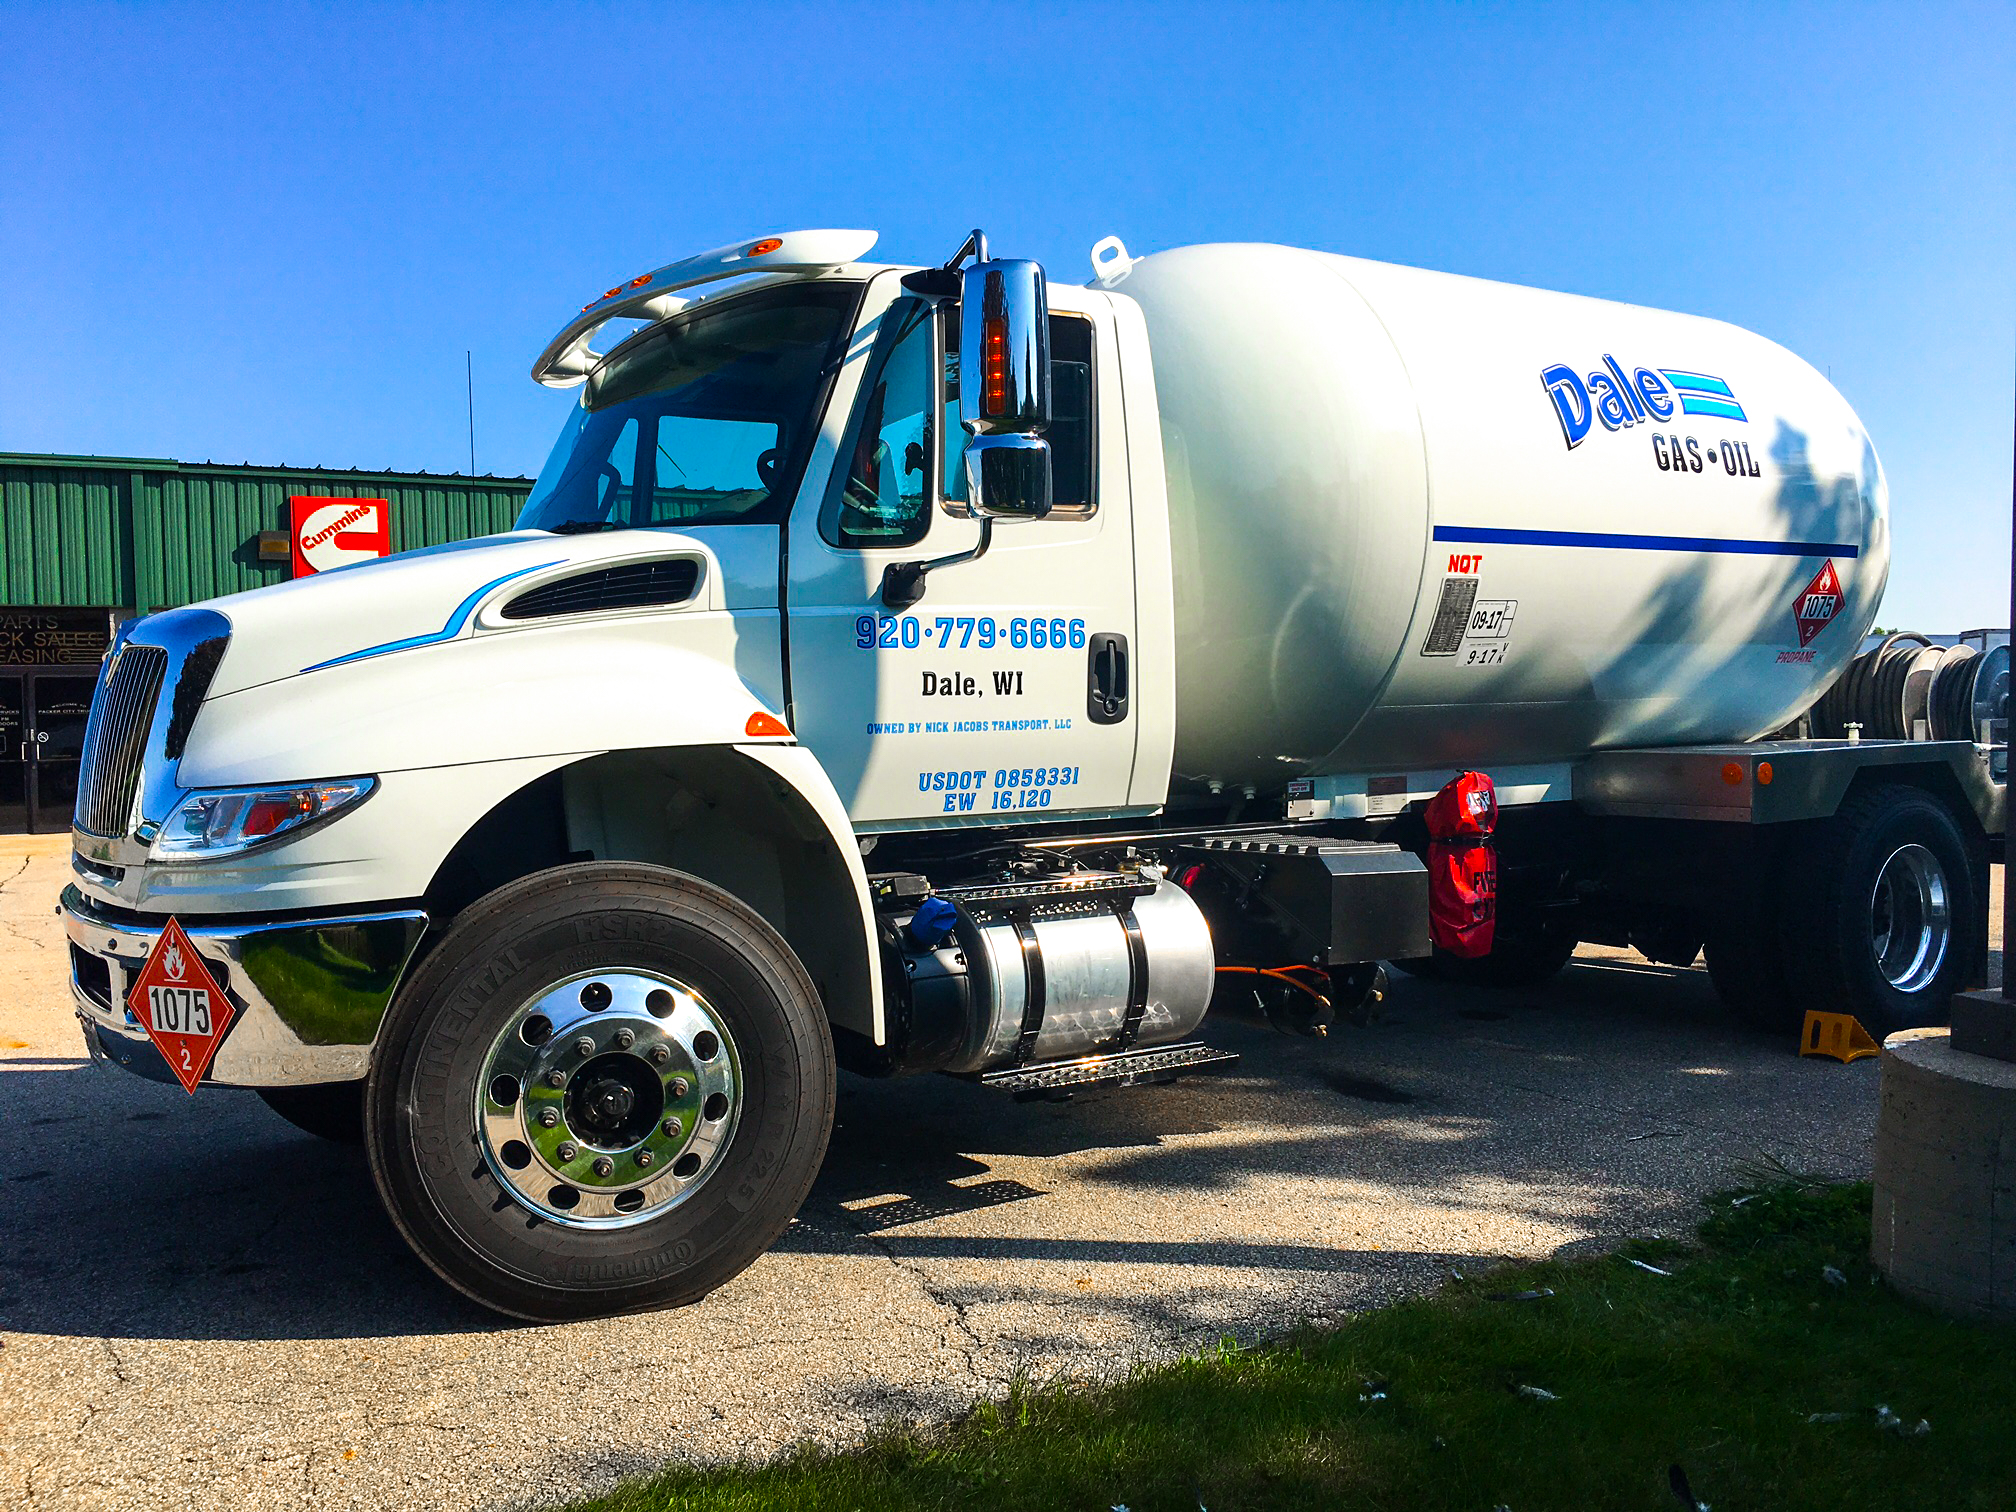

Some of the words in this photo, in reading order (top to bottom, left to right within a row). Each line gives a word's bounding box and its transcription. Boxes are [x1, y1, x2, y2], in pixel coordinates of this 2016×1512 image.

[1540, 354, 1674, 451] Dale
[302, 506, 371, 550] Cummins
[1804, 596, 1835, 618] 1075
[1472, 611, 1503, 630] 09-17
[1805, 626, 1814, 637] 2
[34, 632, 98, 647] SALES
[1776, 651, 1817, 664] PROPANE
[922, 671, 983, 698] Dale,
[992, 671, 1023, 696] WI
[867, 722, 905, 735] OWNED
[908, 722, 922, 734] BY
[925, 721, 949, 733] NICK
[953, 720, 989, 732] JACOBS
[1054, 718, 1072, 730] LLC
[919, 771, 987, 792] USDOT
[994, 767, 1079, 788] 0858331
[943, 793, 977, 812] EW
[992, 789, 1052, 810] 16,120
[575, 915, 675, 944] HSR2
[151, 987, 210, 1034] 1075
[180, 1049, 192, 1071] 2
[416, 946, 532, 1181] CONTINENTAL
